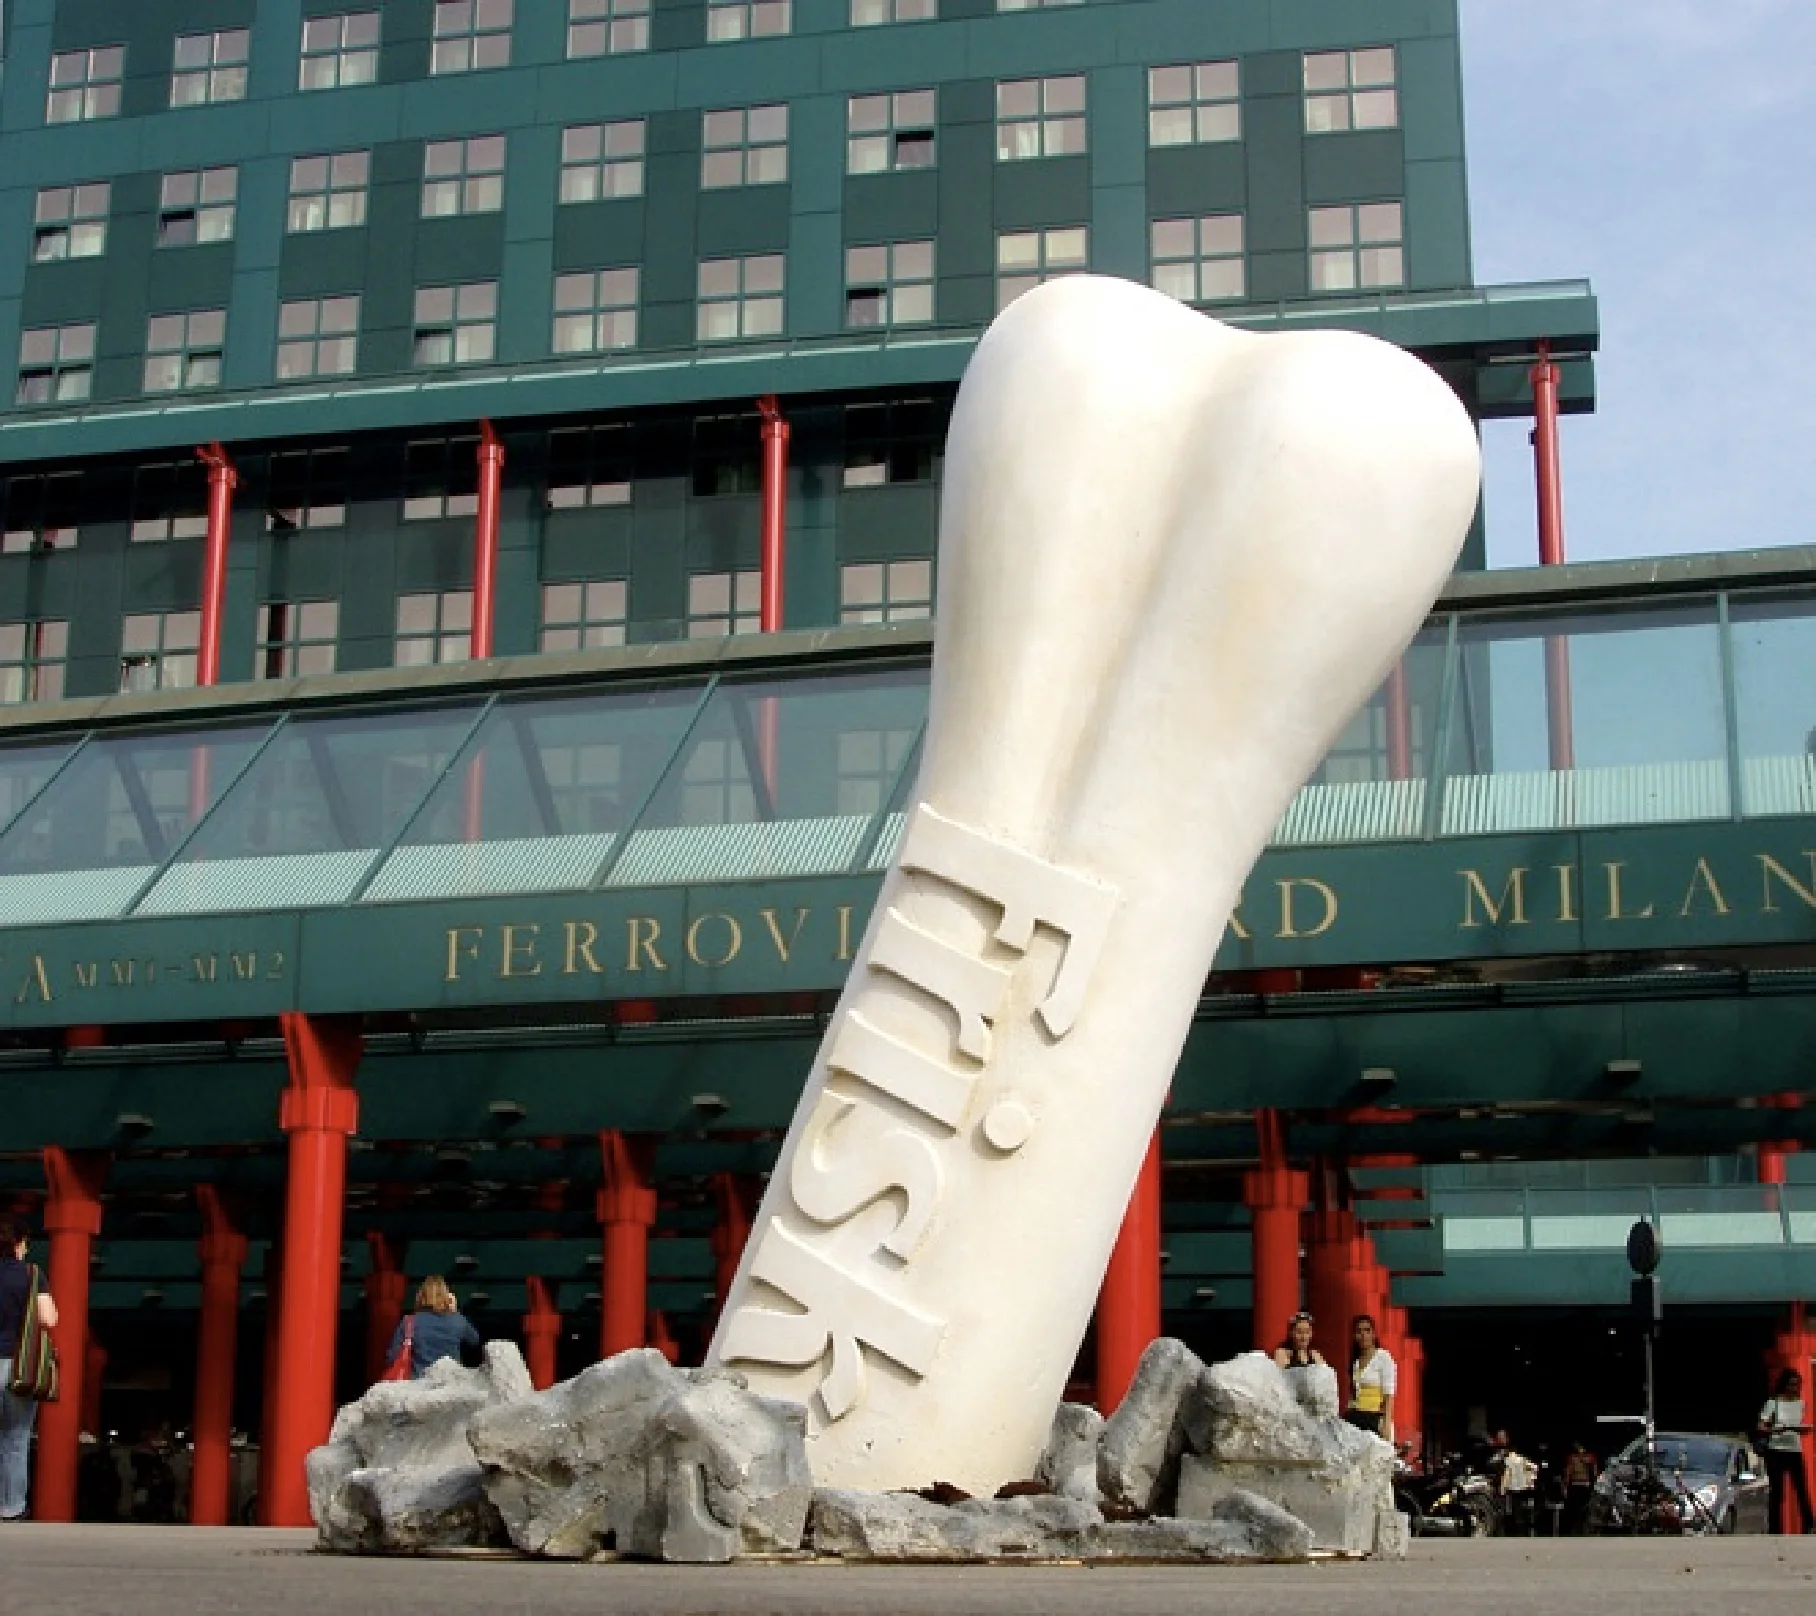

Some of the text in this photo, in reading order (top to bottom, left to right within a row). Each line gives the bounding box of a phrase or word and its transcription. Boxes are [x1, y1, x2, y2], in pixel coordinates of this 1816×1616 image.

[444, 906, 856, 981] FERROVI
[1455, 850, 1816, 928] MILAN
[719, 801, 1120, 1422] Frisk
